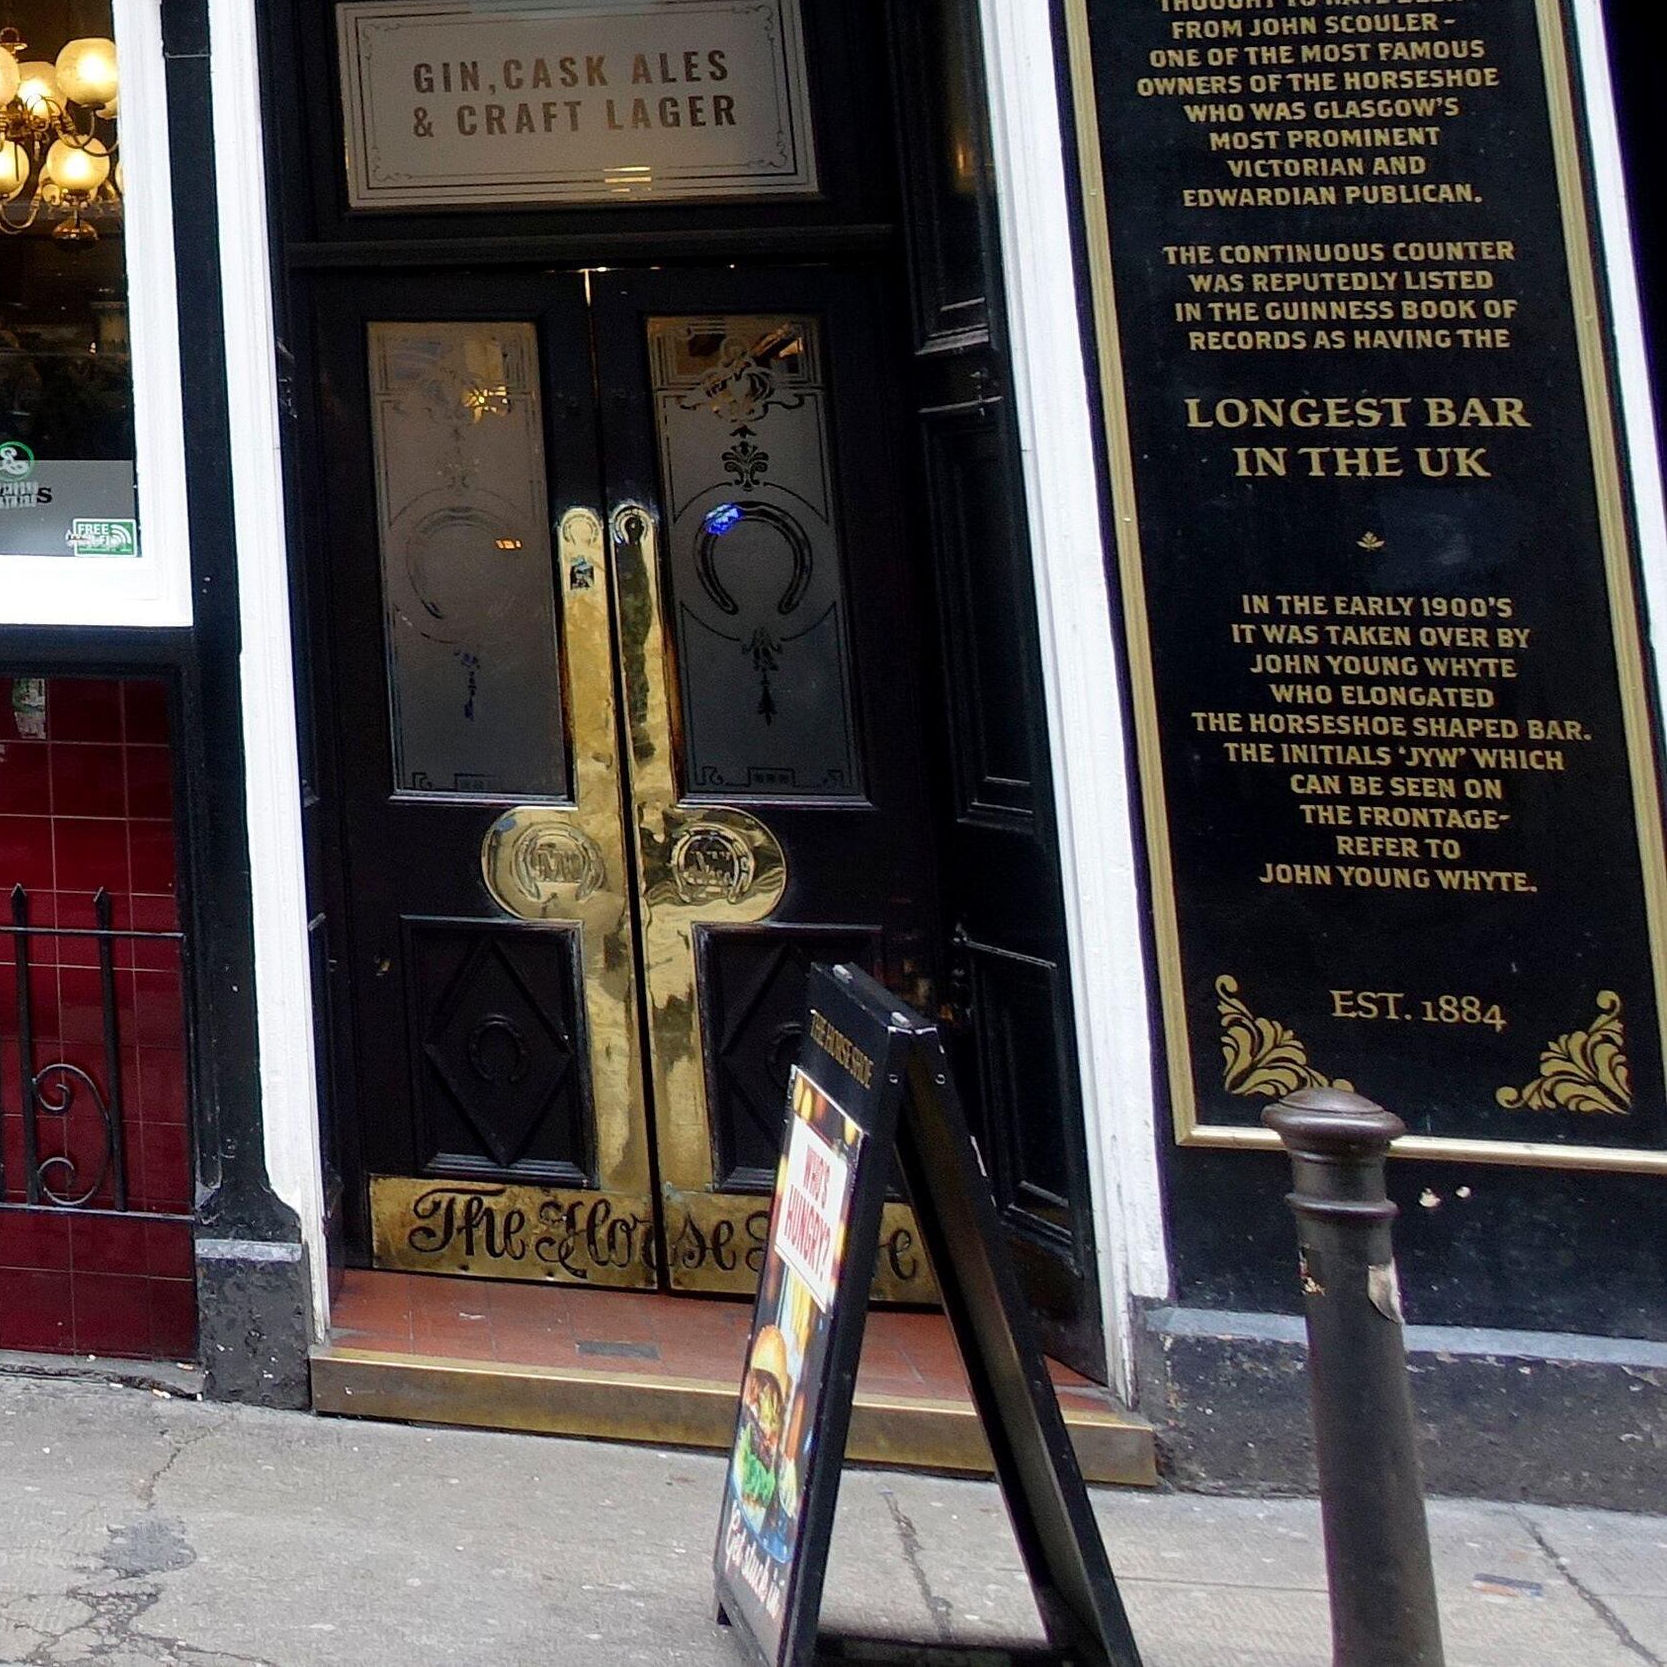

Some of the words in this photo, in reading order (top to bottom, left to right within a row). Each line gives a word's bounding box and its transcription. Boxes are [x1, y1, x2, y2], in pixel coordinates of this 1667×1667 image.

[1171, 19, 1243, 40] FROM
[1249, 16, 1317, 37] JOHN
[1324, 12, 1439, 34] SCOULER
[631, 49, 729, 84] ALES
[1149, 48, 1202, 68] ONE
[1207, 47, 1239, 67] OF
[1243, 45, 1295, 66] THE
[1301, 43, 1371, 63] MOST
[1377, 39, 1485, 61] FAMOUS
[1137, 75, 1242, 97] OWNERS
[1249, 74, 1282, 93] OF
[1285, 72, 1338, 92] THE
[1343, 67, 1499, 90] HORSESHOE
[412, 106, 434, 138] &
[457, 100, 582, 136] CRAFT
[606, 95, 737, 131] LAGER
[1183, 397, 1412, 428] LONGEST
[1423, 397, 1532, 427] BAR
[1232, 447, 1288, 477] IN
[1297, 446, 1403, 477] THE
[1414, 447, 1491, 477] UK
[77, 523, 109, 534] FREE
[1231, 623, 1256, 644] IT
[1261, 624, 1319, 645] WAS
[1325, 625, 1411, 646] TAKEN
[1419, 627, 1490, 648] OVER
[1496, 627, 1530, 649] BY
[1250, 654, 1320, 674] JOHN
[1324, 655, 1418, 676] YOUNG
[1423, 657, 1517, 678] WHYTE
[1269, 684, 1333, 704] WHO
[1341, 685, 1494, 708] ELONGATED
[1299, 804, 1353, 825] THE
[1335, 835, 1419, 858] REFER
[1424, 838, 1461, 859] TO
[1259, 863, 1332, 885] JOHN
[1336, 866, 1430, 889] YOUNG
[1434, 869, 1538, 892] WHYTE.
[1329, 989, 1415, 1021] EST.
[1421, 995, 1508, 1032] 1884
[407, 1188, 527, 1260] The
[784, 1183, 832, 1283] HUNGRY?
